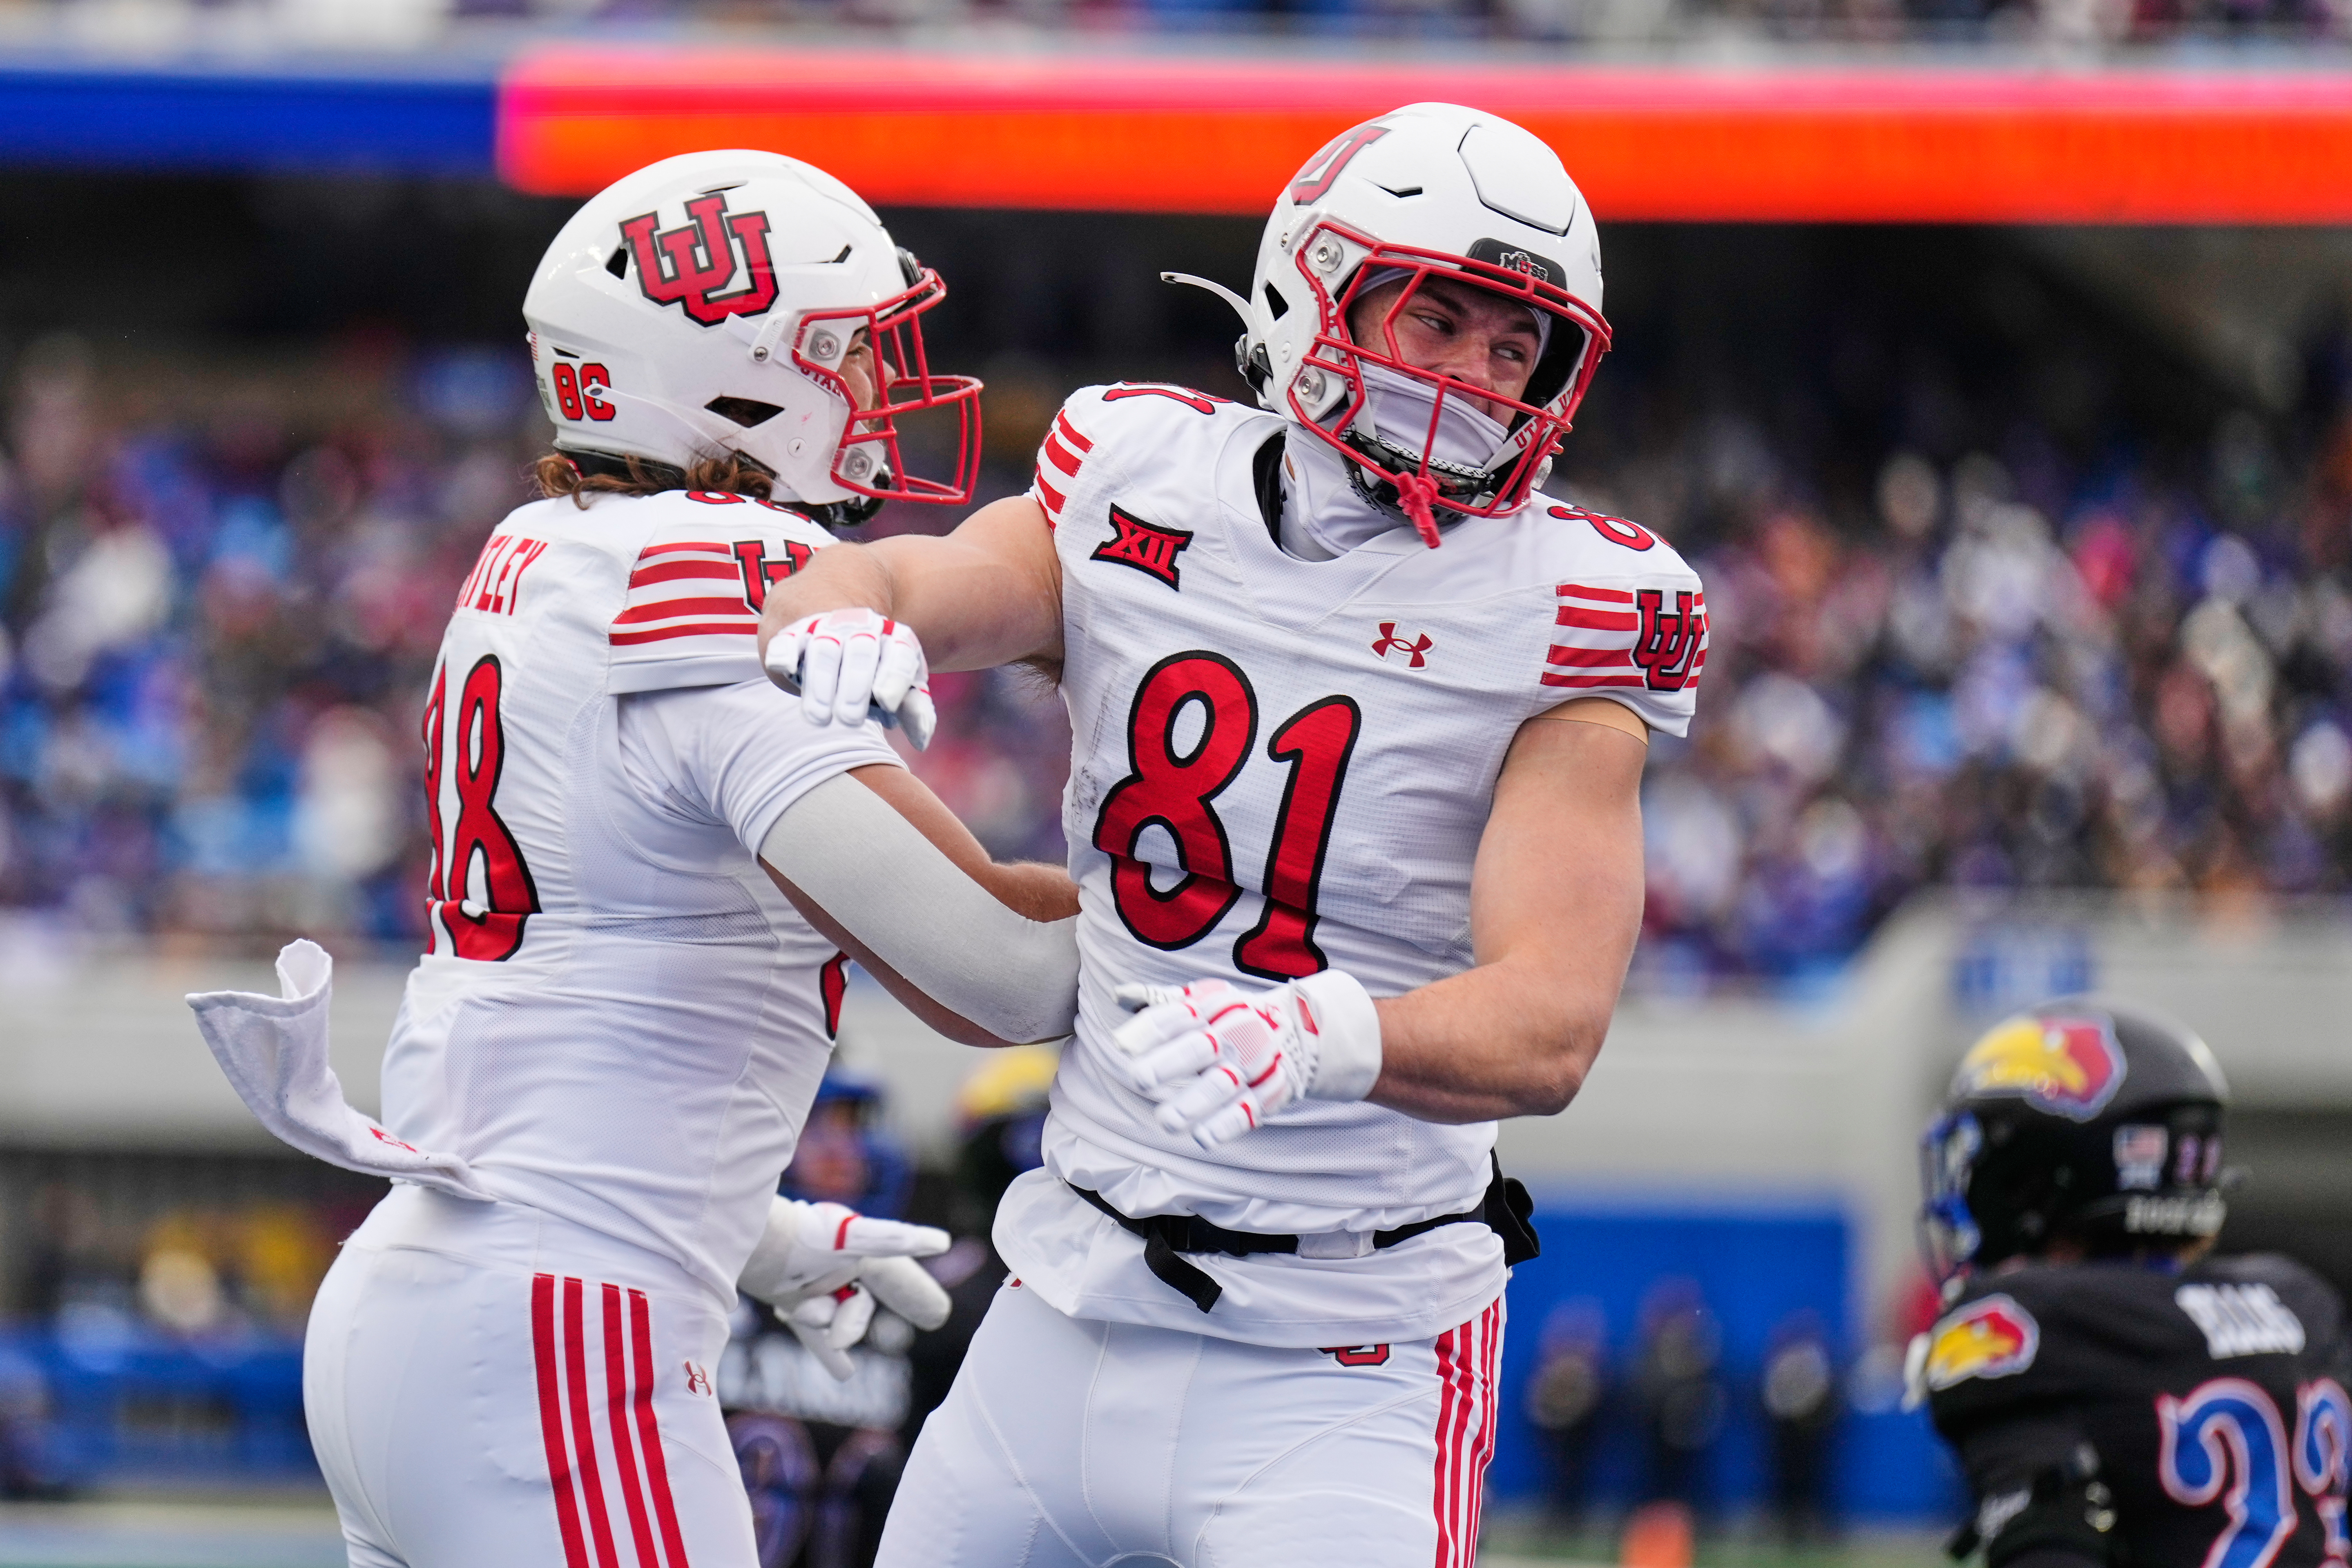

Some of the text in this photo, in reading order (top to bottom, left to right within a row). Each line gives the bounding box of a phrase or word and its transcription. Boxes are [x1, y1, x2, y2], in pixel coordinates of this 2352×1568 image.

[552, 362, 616, 421] 88
[1091, 505, 1192, 589] XII
[1547, 506, 1674, 551] 8
[1093, 650, 1361, 982] 81
